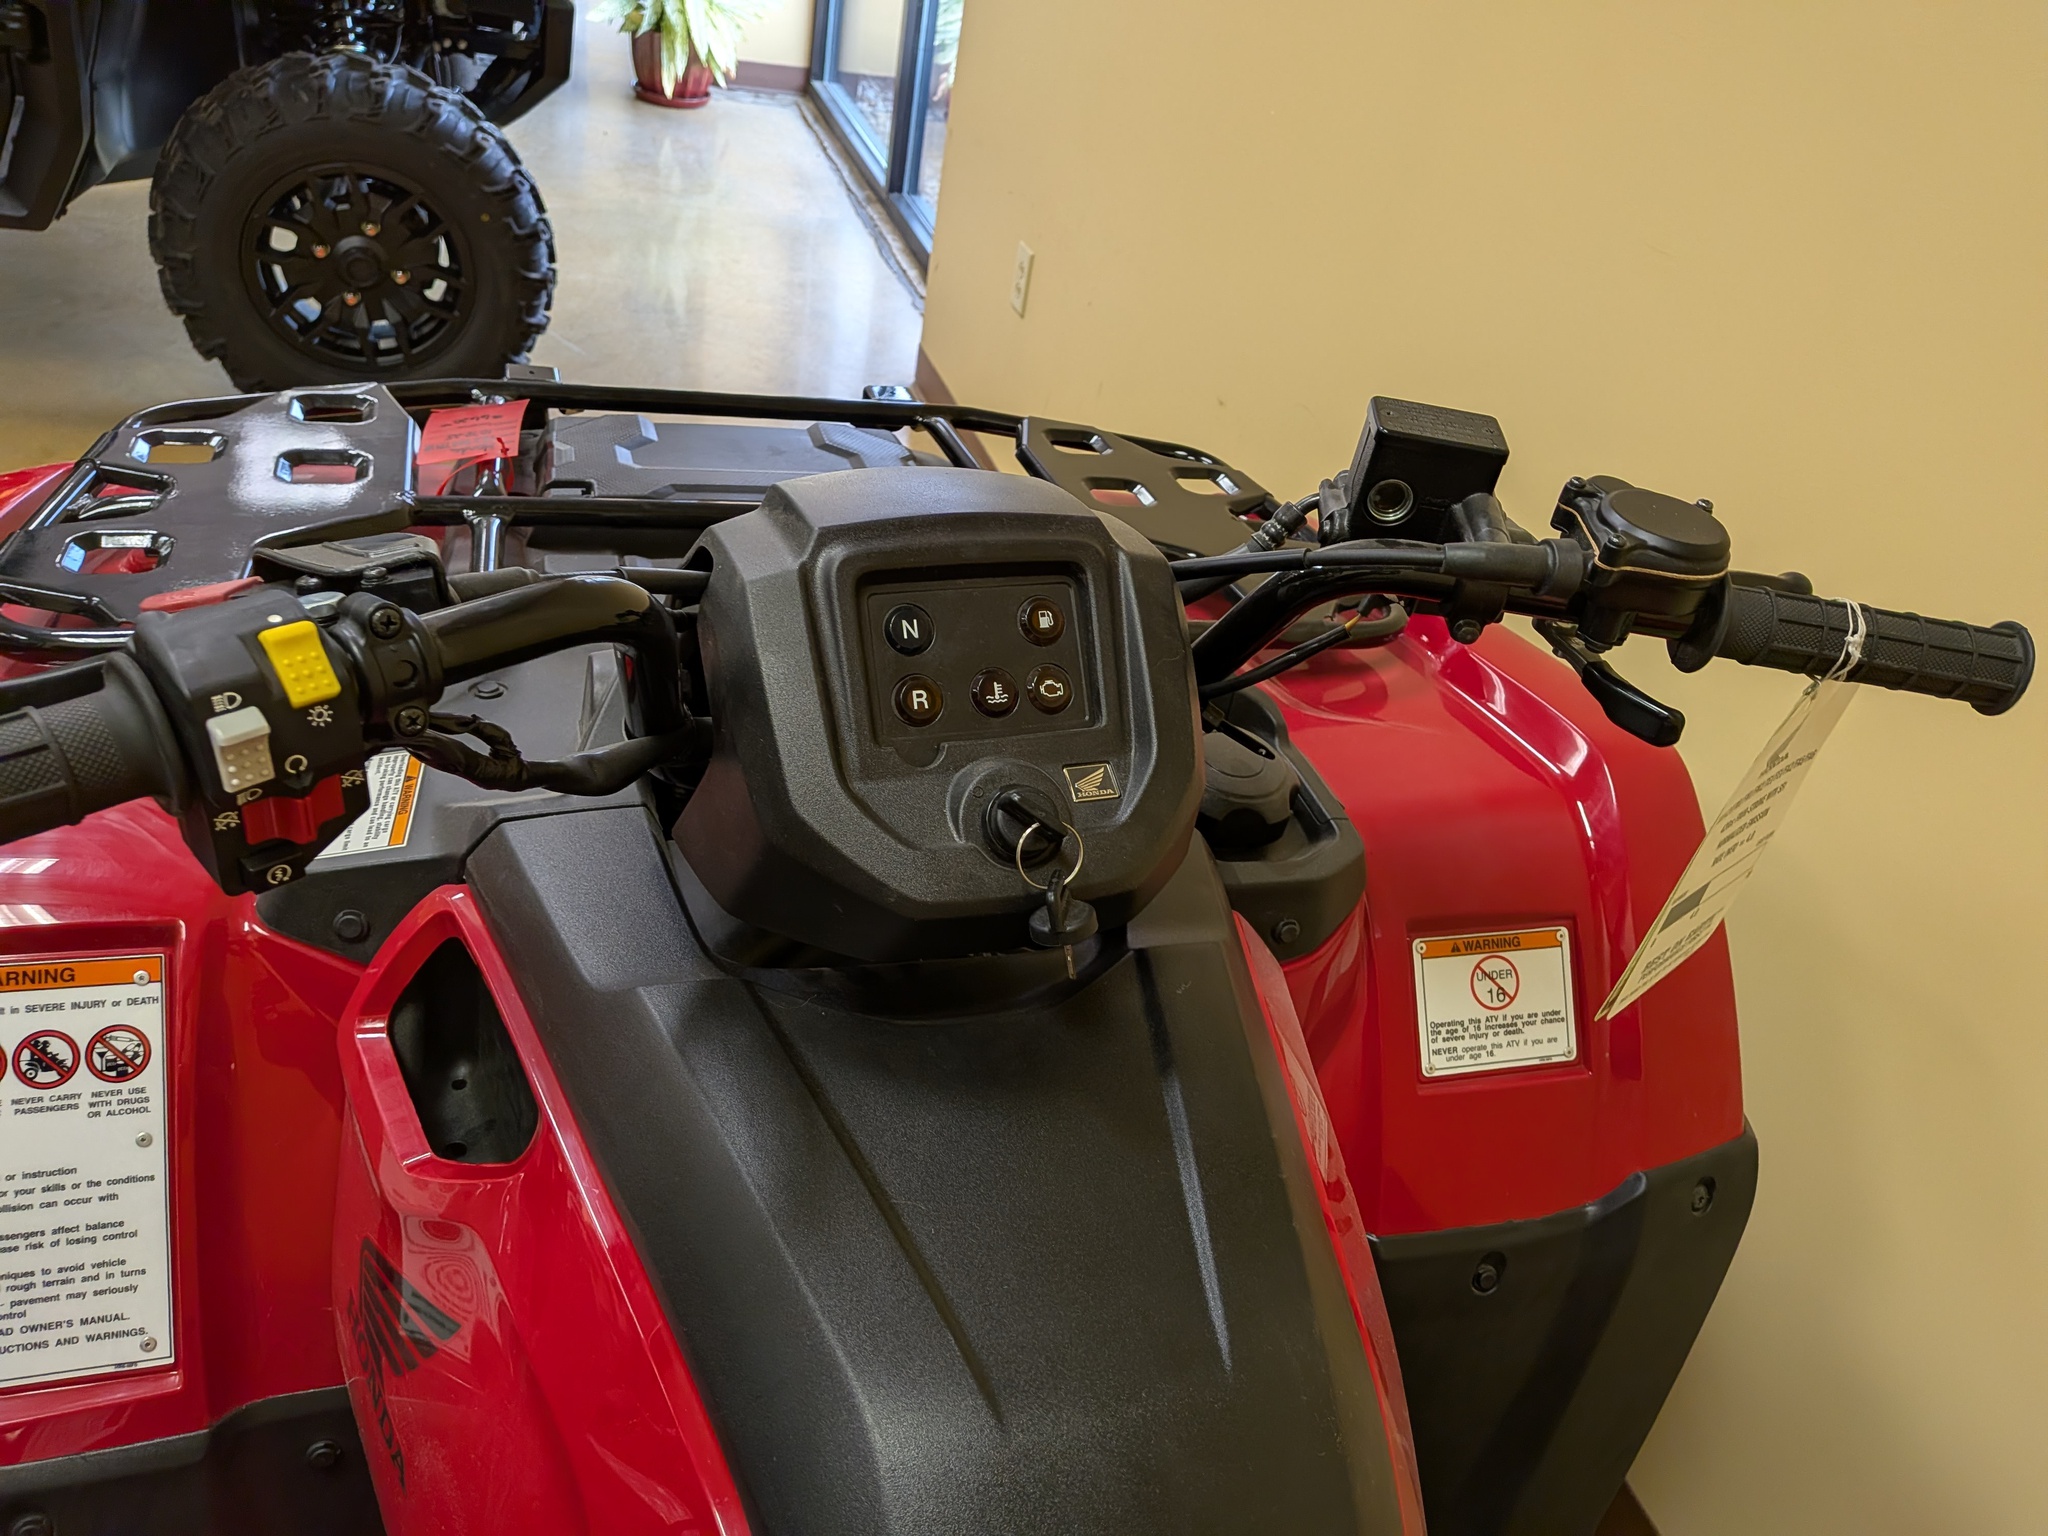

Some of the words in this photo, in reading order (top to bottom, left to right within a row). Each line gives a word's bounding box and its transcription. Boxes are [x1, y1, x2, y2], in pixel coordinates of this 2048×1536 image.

[901, 619, 919, 639] N
[912, 690, 929, 710] R
[398, 784, 413, 815] WARNING
[1077, 788, 1115, 798] HONDA
[1462, 936, 1521, 951] WARNING
[0, 968, 76, 986] RNING
[1476, 969, 1513, 982] UNDER
[1487, 987, 1506, 1003] 16
[25, 1002, 65, 1013] SEVERE
[71, 1000, 107, 1010] INJURY
[126, 996, 160, 1006] DEATH
[1430, 1020, 1464, 1030] Operating
[1468, 1016, 1481, 1024] this
[1485, 1015, 1499, 1023] ATV
[1511, 1014, 1524, 1022] you
[1542, 1010, 1561, 1018] under
[1445, 1028, 1458, 1036] age
[1485, 1021, 1518, 1030] increases
[1521, 1020, 1537, 1028] your
[1540, 1016, 1565, 1025] chance
[1431, 1036, 1438, 1044] of
[1442, 1034, 1465, 1042] severe
[1469, 1031, 1488, 1041] injury
[1504, 1027, 1524, 1036] death.
[1432, 1047, 1458, 1056] NEVER
[1461, 1044, 1487, 1054] operate
[1506, 1040, 1520, 1048] ATV
[1531, 1038, 1543, 1047] you
[1446, 1054, 1465, 1062] under
[1469, 1052, 1482, 1060] age
[1486, 1050, 1496, 1058] 16.
[11, 1096, 44, 1105] NEVER
[50, 1092, 82, 1102] CARRY
[91, 1088, 122, 1098] NEVER
[128, 1086, 147, 1095] USE
[14, 1103, 80, 1115] PASSENGERS
[88, 1100, 113, 1109] WITH
[117, 1096, 150, 1106] DRUGS
[106, 1106, 151, 1117] ALCOHOL
[22, 1167, 78, 1180] instruction
[14, 1187, 36, 1198] your
[41, 1183, 66, 1193] skills
[71, 1182, 82, 1190] or
[86, 1179, 102, 1188] the
[106, 1174, 155, 1186] conditions
[39, 1200, 58, 1209] can
[64, 1196, 92, 1206] occur
[98, 1192, 119, 1202] with
[51, 1225, 80, 1236] affect
[86, 1220, 124, 1231] balance
[25, 1240, 44, 1250] risk
[50, 1238, 61, 1248] of
[66, 1234, 97, 1246] losing
[102, 1229, 138, 1241] control
[41, 1268, 51, 1276] to
[57, 1262, 85, 1274] avoid
[90, 1258, 126, 1270] vehicle
[6, 1281, 36, 1292] rough
[42, 1277, 75, 1288] terrain
[80, 1273, 100, 1282] and
[120, 1268, 147, 1278] turns
[10, 1294, 60, 1309] pavement
[66, 1290, 87, 1301] may
[92, 1283, 139, 1297] seriously
[20, 1319, 74, 1334] OWNER'S
[80, 1312, 130, 1326] MANUAL.
[55, 1336, 79, 1348] AND
[85, 1327, 148, 1342] WARNINGS.
[347, 1286, 407, 1497] HONDA
